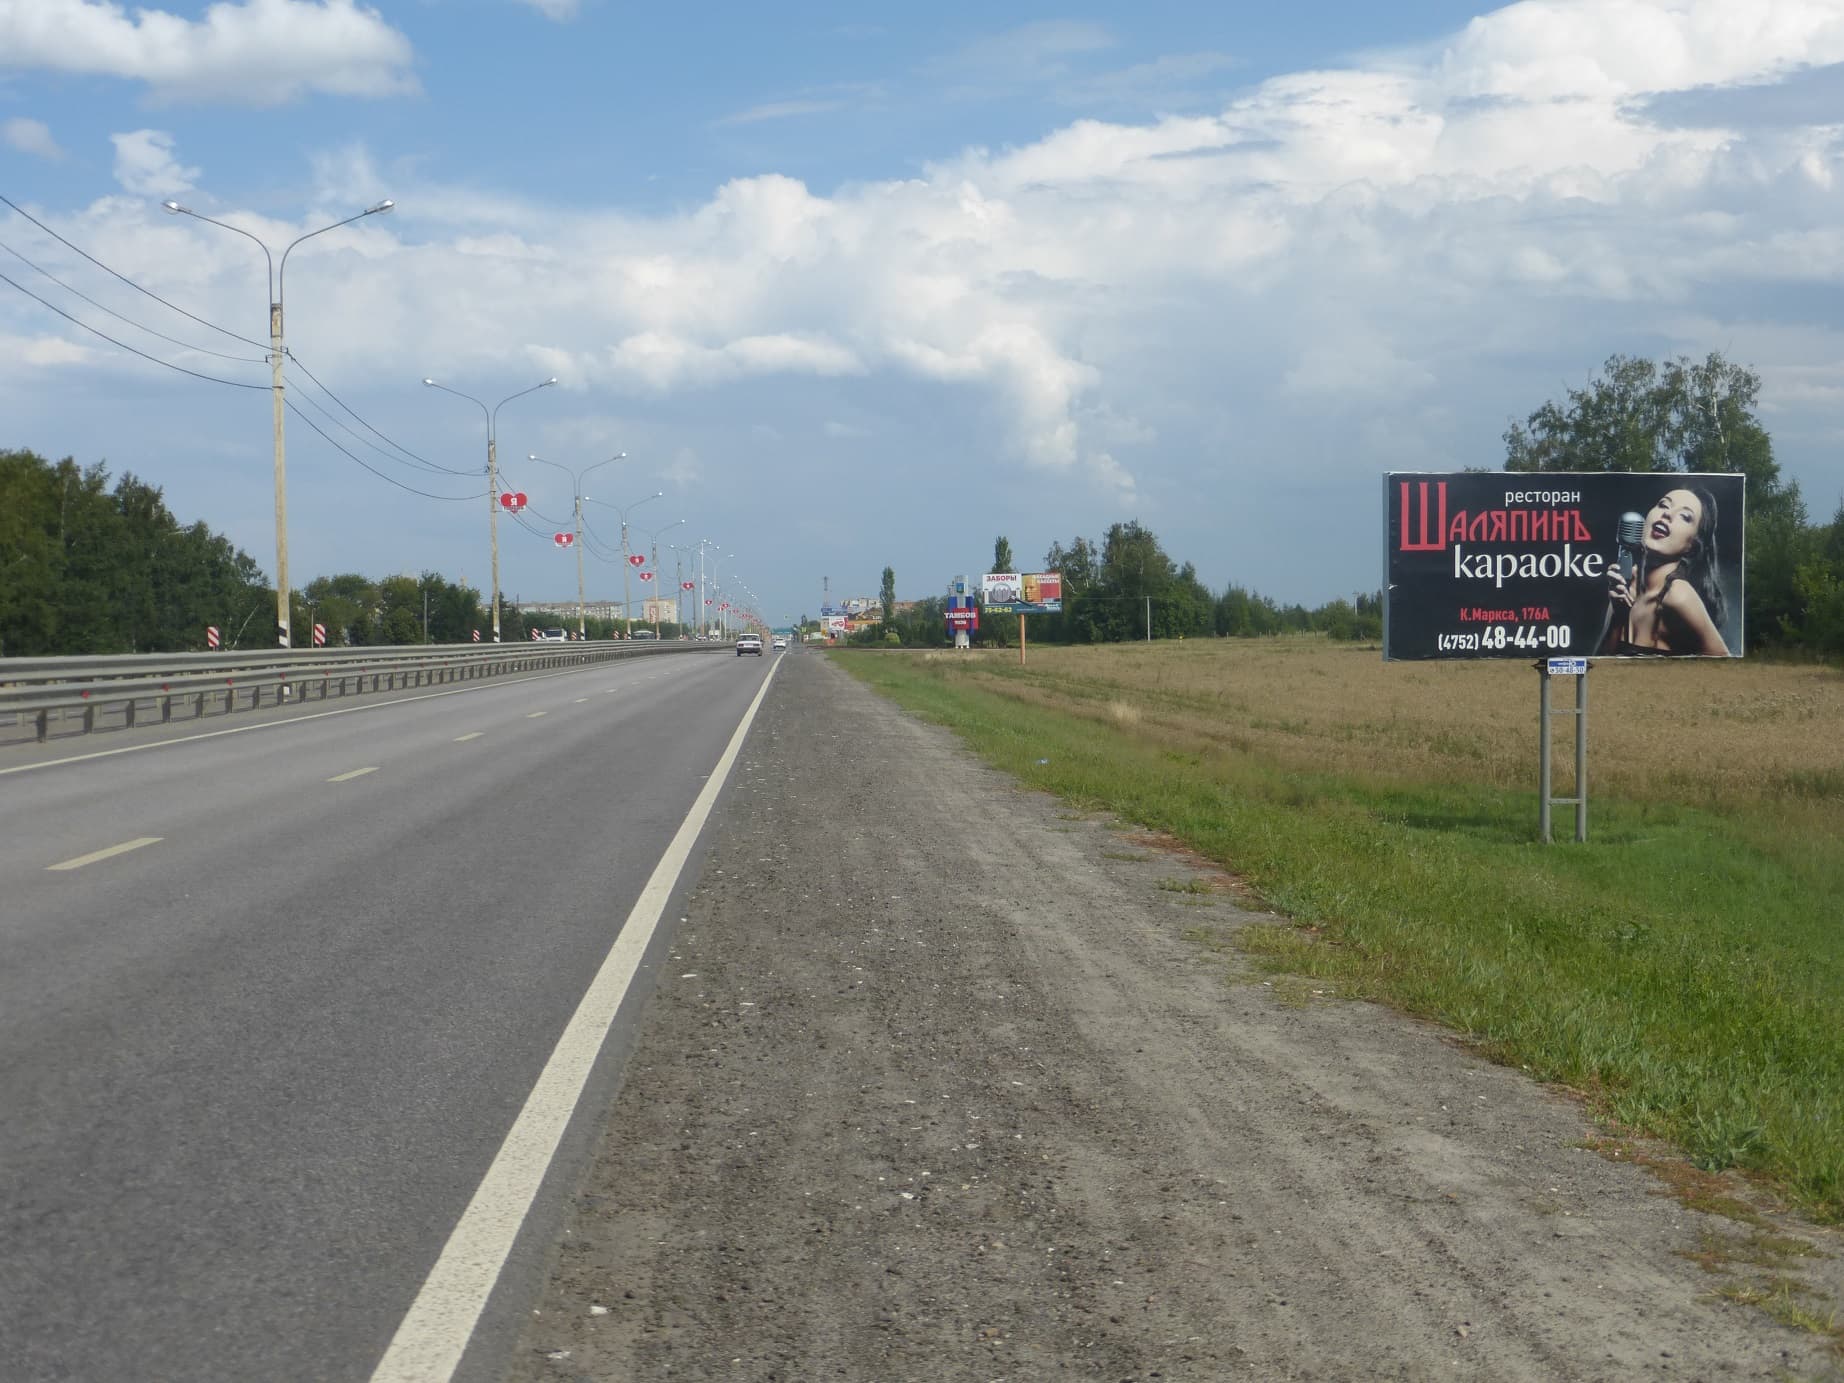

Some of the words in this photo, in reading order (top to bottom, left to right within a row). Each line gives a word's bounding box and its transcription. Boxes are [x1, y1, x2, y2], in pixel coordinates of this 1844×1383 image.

[1505, 489, 1581, 507] ресторан
[1454, 543, 1603, 588] караоке
[1522, 607, 1550, 621] 176А
[1438, 633, 1479, 651] (4752)
[1481, 625, 1571, 649] 48-44-00
